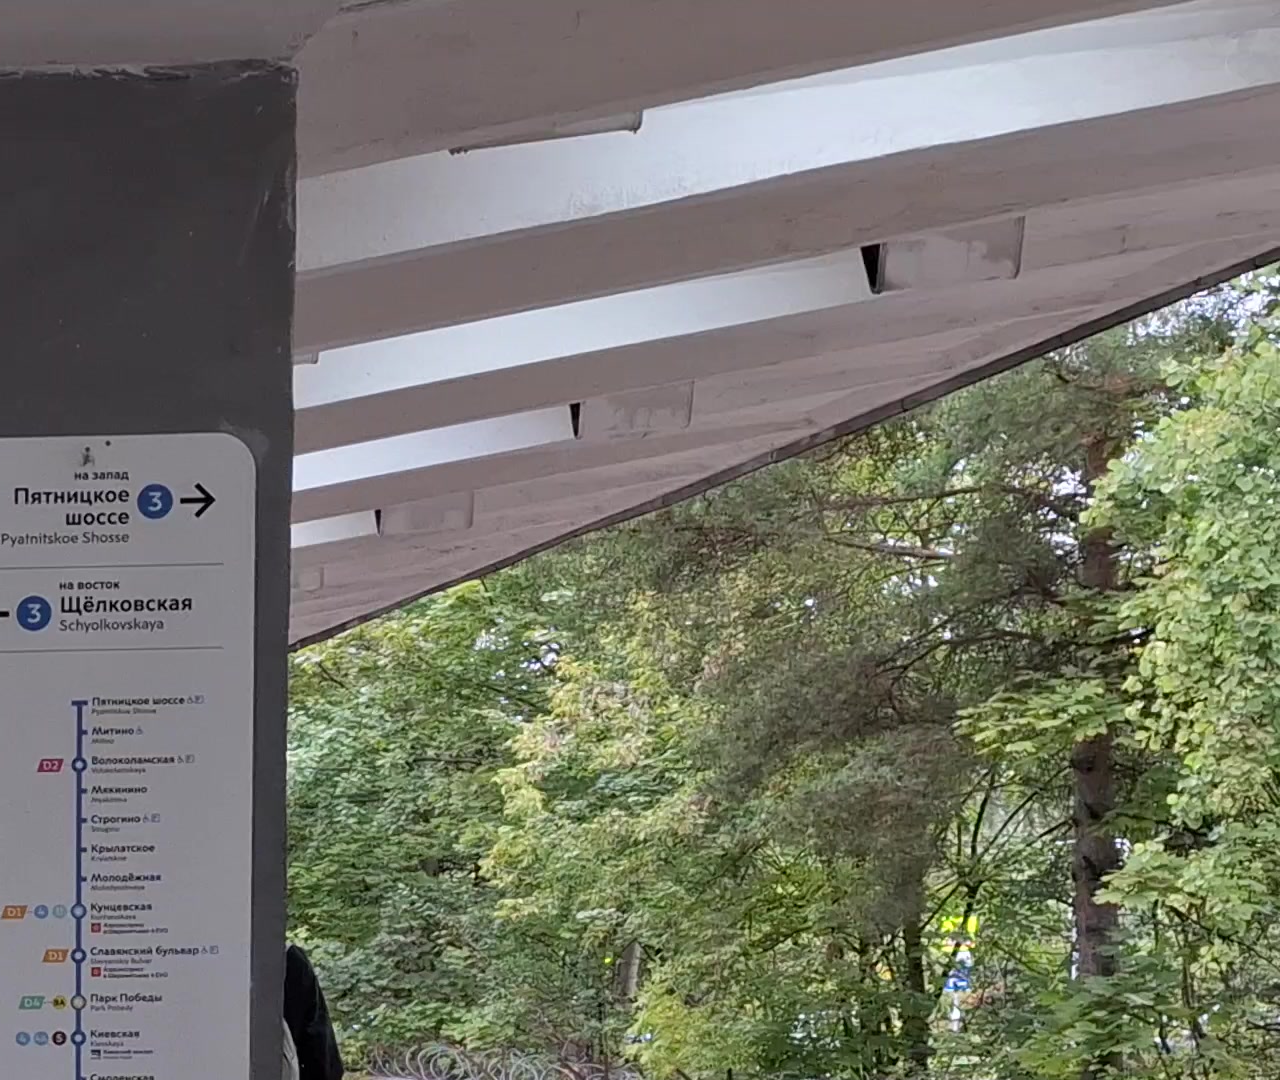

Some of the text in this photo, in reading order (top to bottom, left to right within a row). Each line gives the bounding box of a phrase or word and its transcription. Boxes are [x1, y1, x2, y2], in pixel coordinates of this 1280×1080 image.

[74, 470, 130, 482] на запад
[13, 487, 130, 506] Пятницкое
[147, 492, 162, 511] 3
[65, 511, 130, 526] шоссе
[0, 531, 130, 546] Pyatnitskoe Shosse
[59, 580, 120, 590] на восток
[60, 596, 193, 616] Щёлковская
[27, 603, 42, 623] 3
[59, 618, 164, 633] Schyolkovskaya
[92, 697, 185, 706] Пятницкое шоссе
[91, 727, 135, 735] Митино
[91, 756, 175, 765] Волоколамская
[42, 761, 59, 771] D2
[91, 785, 148, 794] Мякинино
[91, 814, 141, 824] Строгино
[91, 844, 156, 854] Крылатское
[91, 873, 162, 883] Молодёжная
[7, 907, 22, 917] D1
[91, 903, 153, 913] Кунцевская
[48, 951, 64, 961] D1
[90, 946, 199, 957] Славянский бульвар
[91, 994, 162, 1004] Парк Победы
[90, 1030, 140, 1039] Киевская
